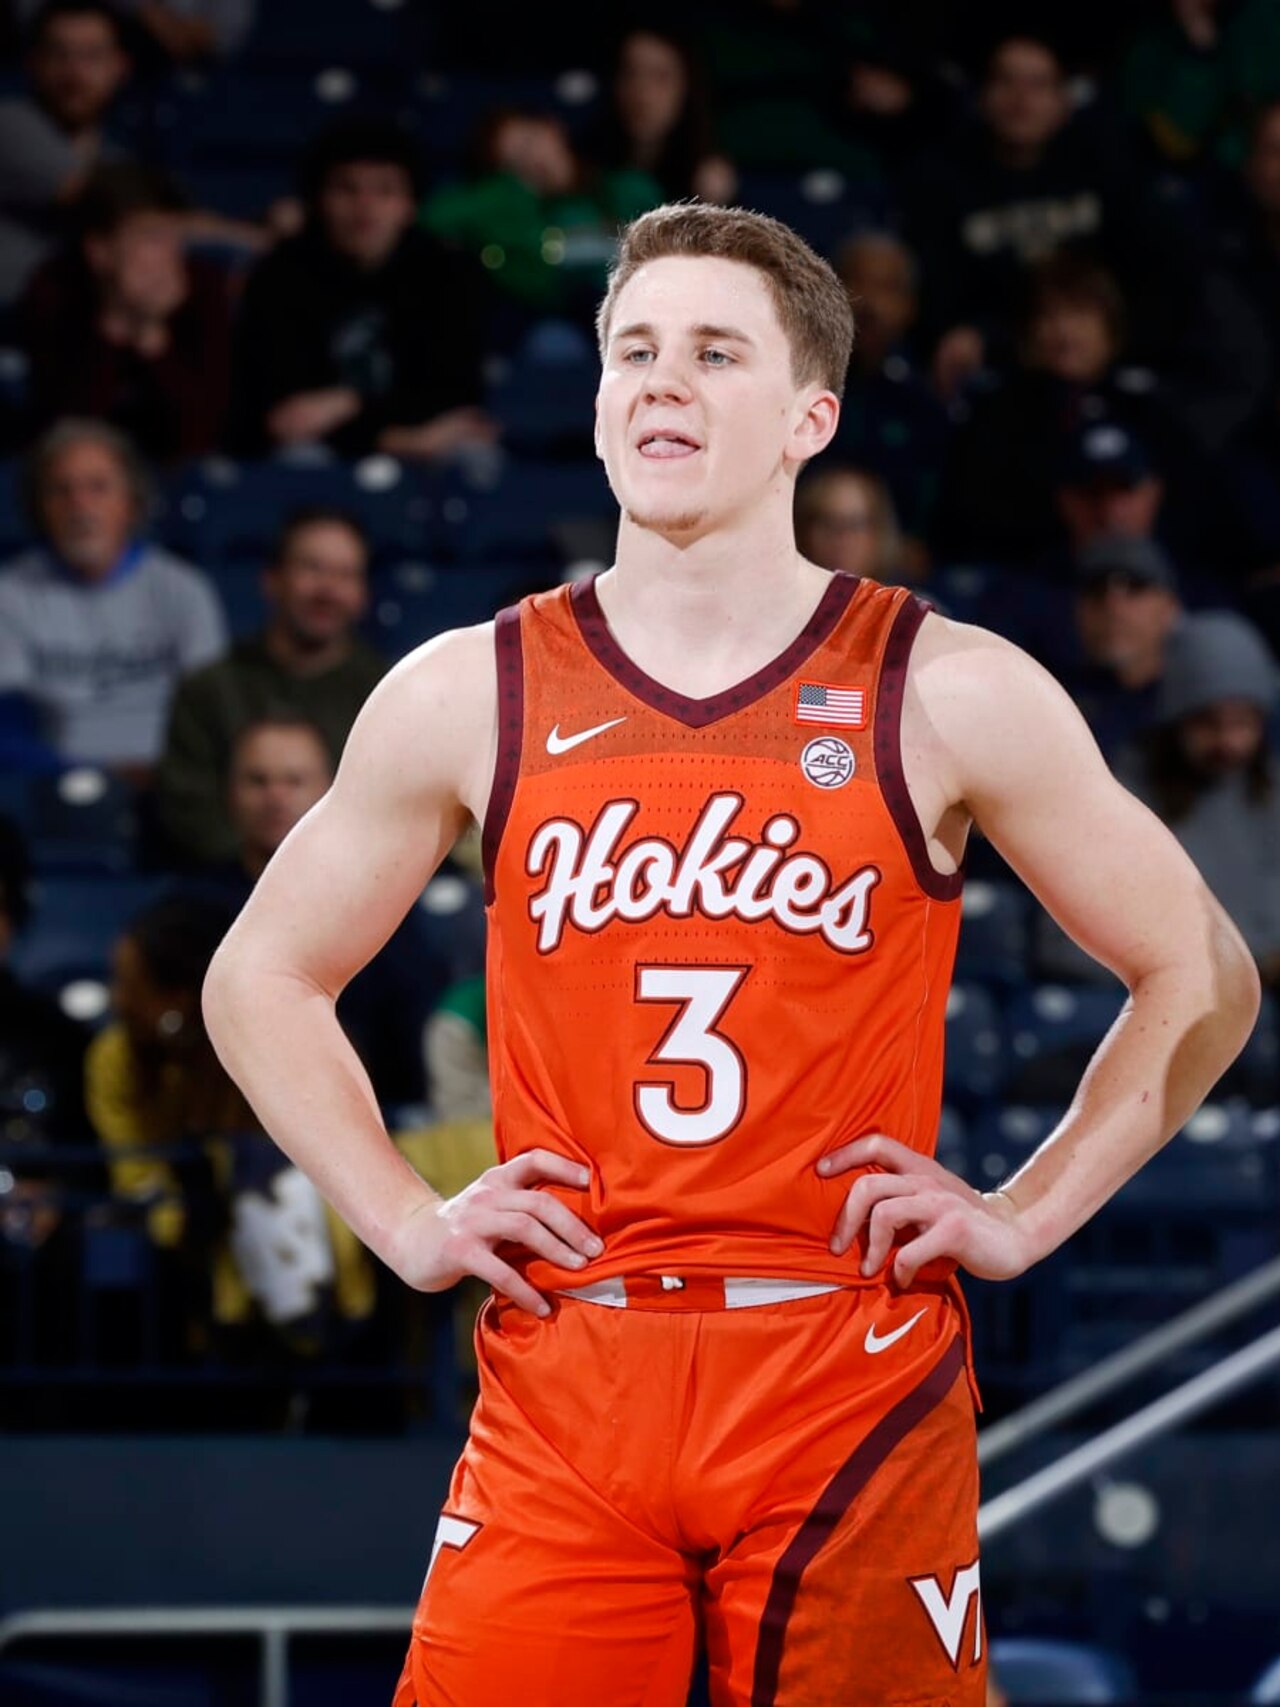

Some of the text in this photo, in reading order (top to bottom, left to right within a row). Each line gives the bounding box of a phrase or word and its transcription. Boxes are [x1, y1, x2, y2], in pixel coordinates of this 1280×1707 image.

[810, 753, 850, 767] ACC
[527, 791, 881, 955] Hokies
[634, 963, 752, 1147] 3
